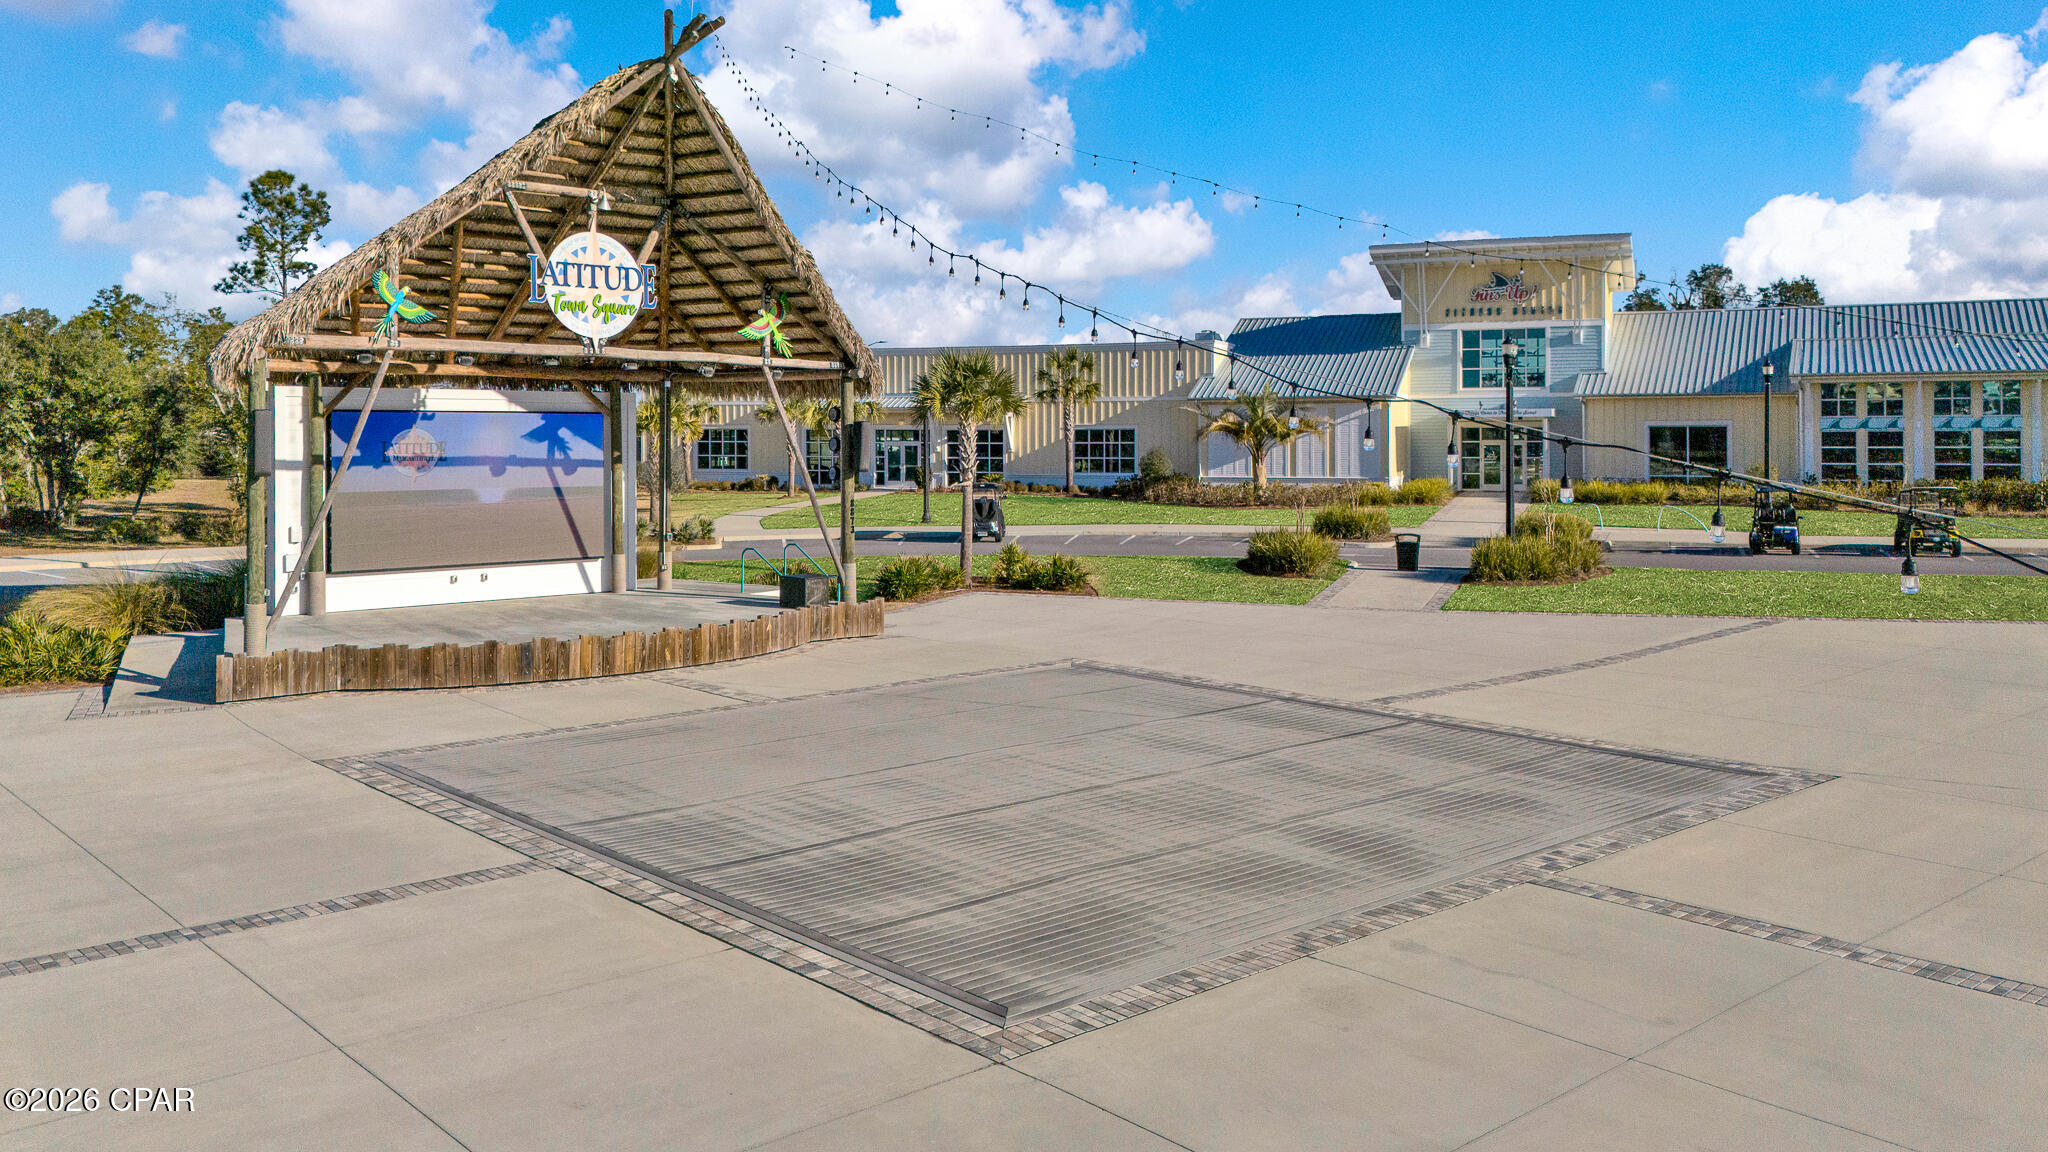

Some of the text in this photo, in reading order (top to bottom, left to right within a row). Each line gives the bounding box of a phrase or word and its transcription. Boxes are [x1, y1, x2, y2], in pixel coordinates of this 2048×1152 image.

[527, 253, 658, 310] LATITUDE
[551, 292, 638, 325] Town Square
